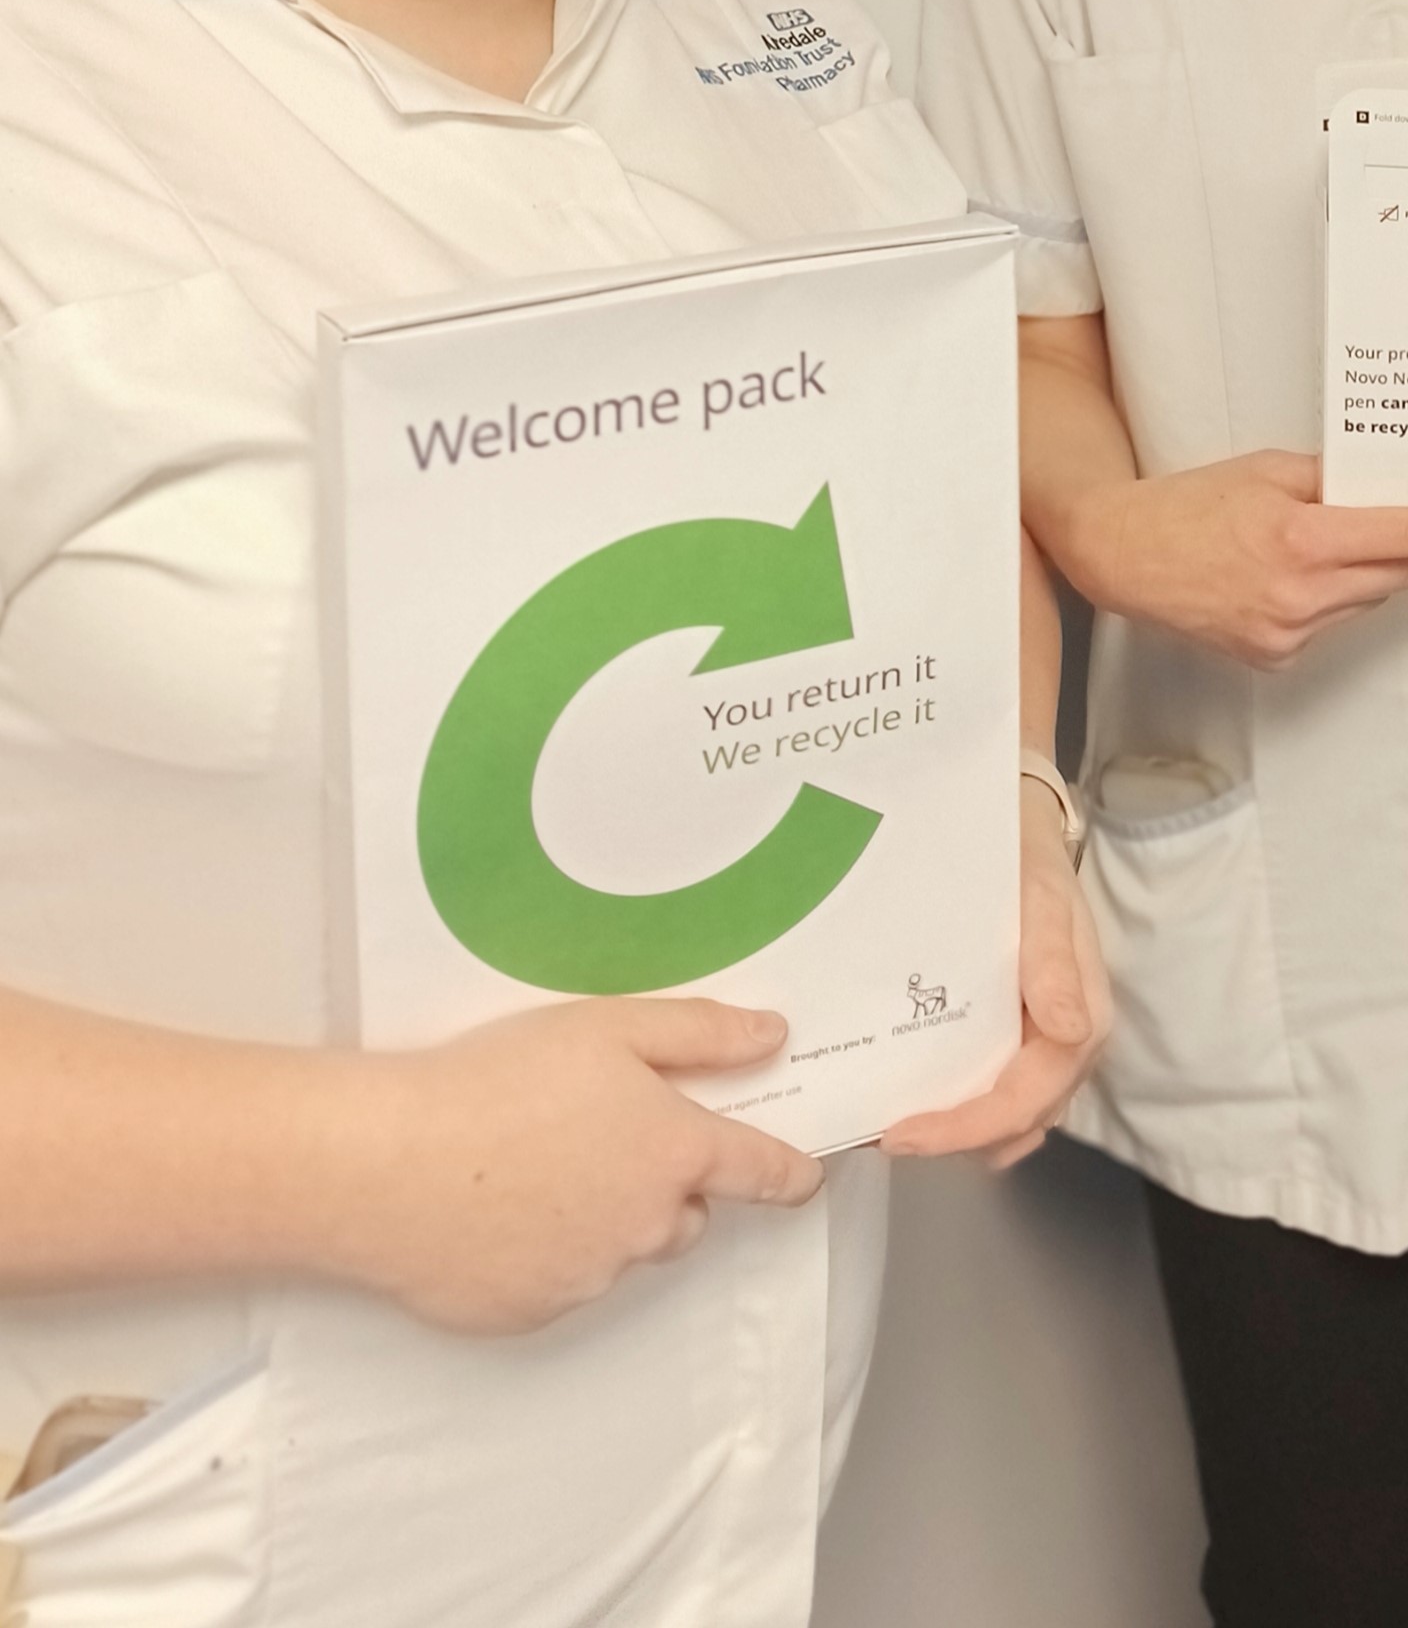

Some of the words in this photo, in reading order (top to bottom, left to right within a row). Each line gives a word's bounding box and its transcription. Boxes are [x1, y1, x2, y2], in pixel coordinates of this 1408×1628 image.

[769, 8, 813, 30] NHS
[794, 36, 843, 67] Trust
[1374, 113, 1392, 123] Fold
[1345, 344, 1383, 360] Your
[1345, 370, 1388, 385] Novo
[406, 384, 681, 473] Welcome
[700, 350, 828, 430] pack
[1344, 397, 1376, 412] pen
[1344, 418, 1365, 433] be
[702, 697, 773, 732] You
[786, 666, 902, 714] return
[915, 654, 937, 684] it
[702, 741, 762, 775] We
[775, 706, 902, 758] recycle
[914, 697, 937, 725] it
[891, 1020, 921, 1037] novo
[922, 1007, 968, 1028] nordisk
[790, 1047, 829, 1064] Brought
[831, 1044, 842, 1053] to
[843, 1039, 861, 1052] you
[733, 1095, 761, 1112] again
[760, 1089, 784, 1104] after
[785, 1085, 803, 1097] use
